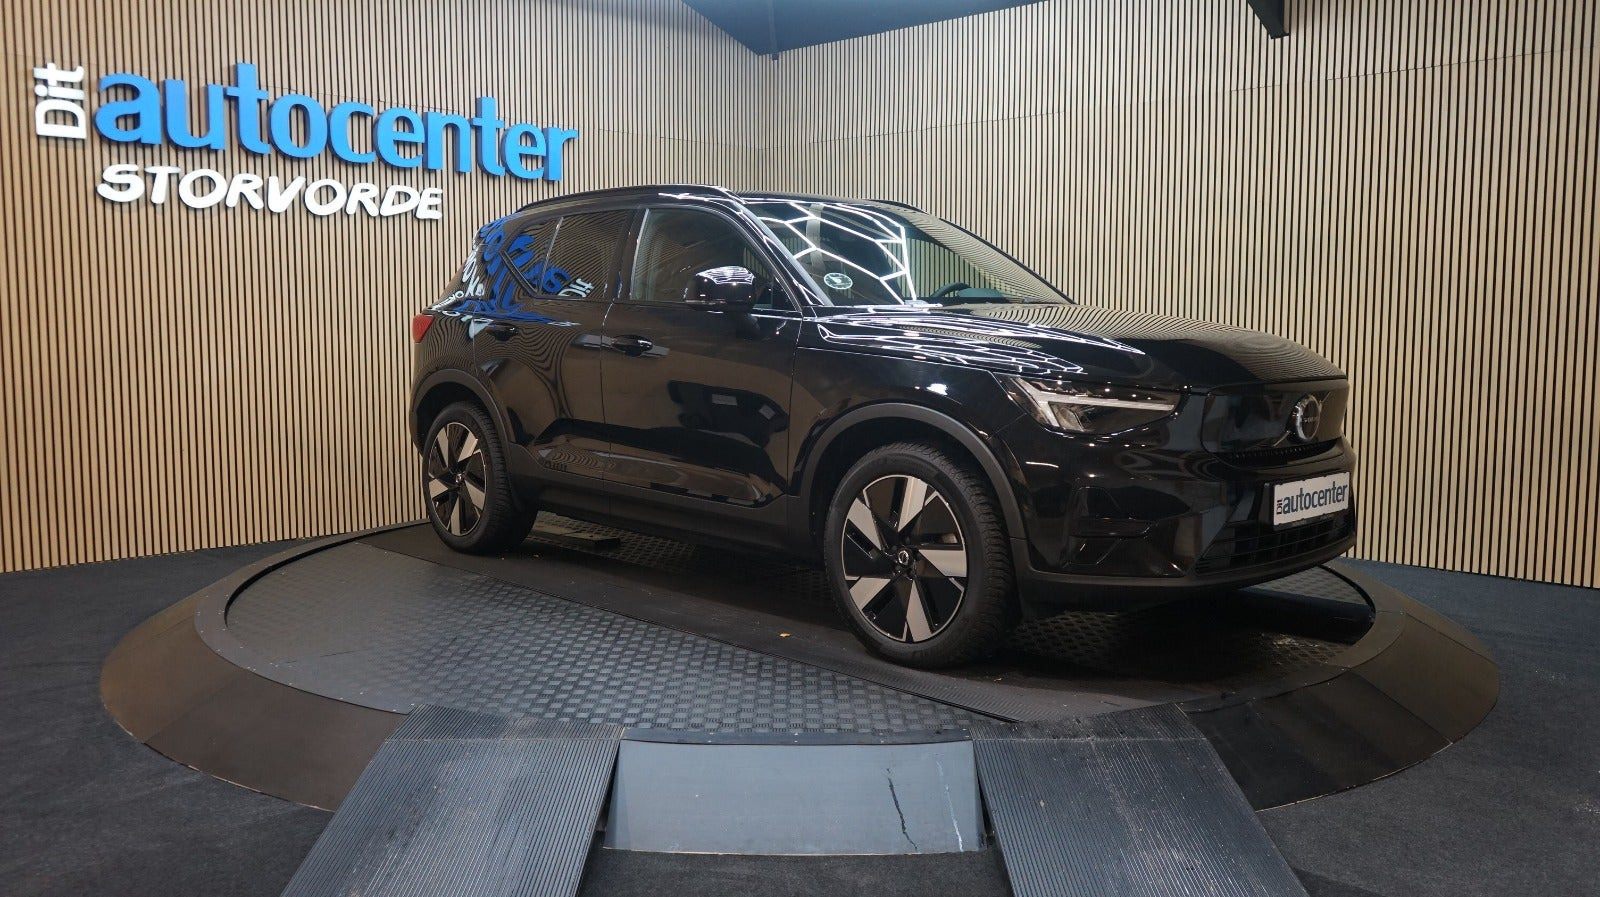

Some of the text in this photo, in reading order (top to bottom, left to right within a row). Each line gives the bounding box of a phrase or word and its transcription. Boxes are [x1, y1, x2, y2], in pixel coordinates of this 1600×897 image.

[33, 61, 579, 182] Dit autocenter
[96, 163, 443, 220] STORVORDE
[1283, 481, 1348, 514] autocenter
